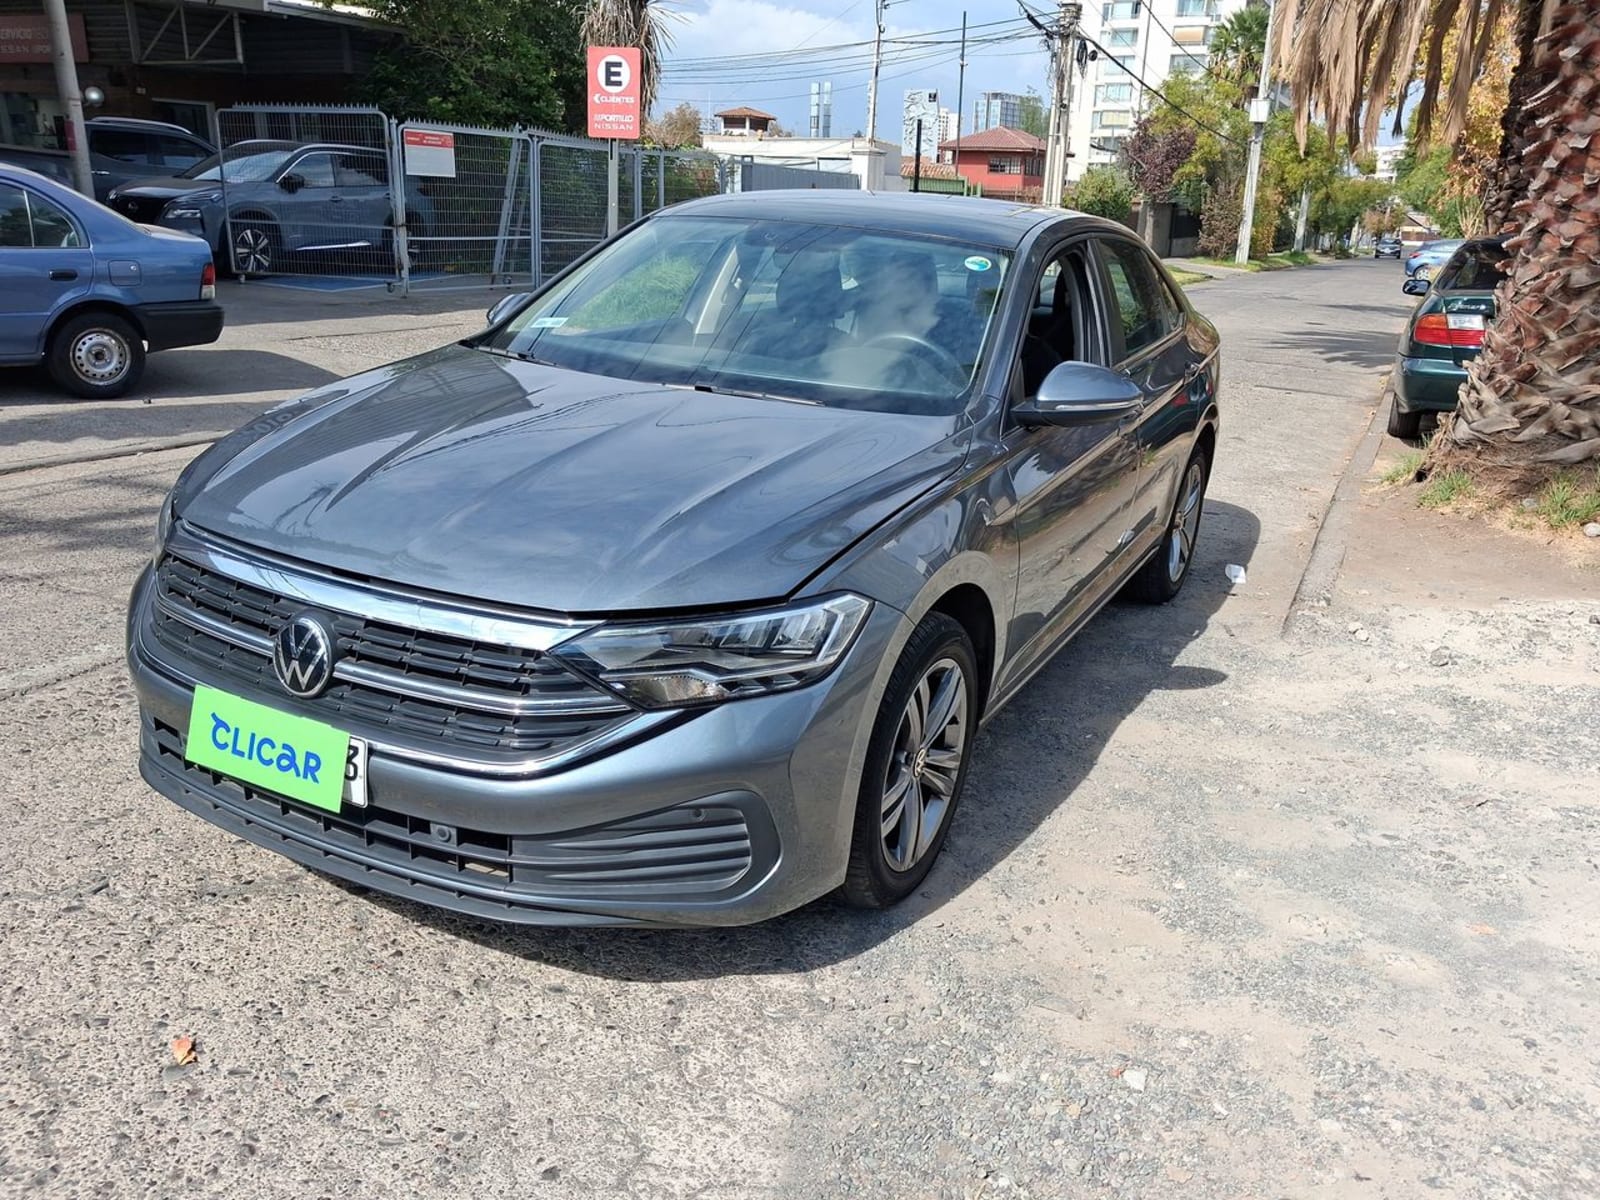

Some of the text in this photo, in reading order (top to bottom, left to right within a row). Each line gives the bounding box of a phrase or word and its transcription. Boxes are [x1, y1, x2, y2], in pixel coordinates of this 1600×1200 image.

[0, 28, 32, 40] ERVICIO
[605, 62, 622, 86] E
[600, 96, 634, 104] CLIENTES
[594, 122, 633, 131] NISSAN
